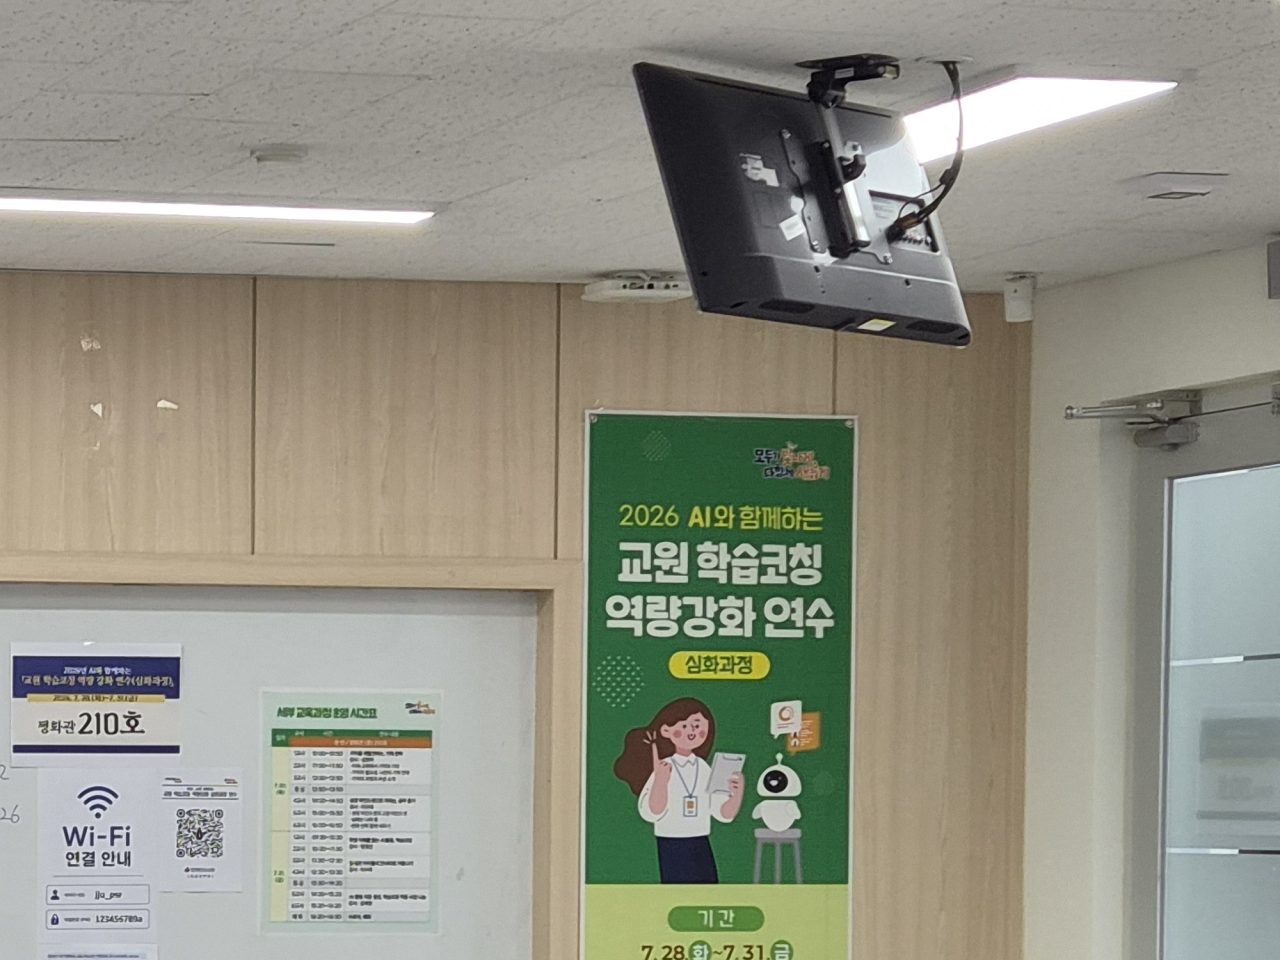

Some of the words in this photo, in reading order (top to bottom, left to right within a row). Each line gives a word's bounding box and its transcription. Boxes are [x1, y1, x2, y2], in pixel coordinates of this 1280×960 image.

[618, 504, 680, 527] 2026
[687, 504, 737, 529] AI와
[739, 505, 824, 531] 함께하는
[617, 541, 689, 583] 교원
[696, 541, 822, 586] 학습코칭
[605, 595, 757, 638] 역량강화
[763, 596, 835, 639] 연수
[684, 655, 753, 675] 심화과정
[38, 719, 77, 735] 평화관
[78, 711, 146, 736] 210호
[62, 825, 131, 847] Wi-Fi
[65, 851, 96, 868] 연결
[100, 851, 131, 868] 안내
